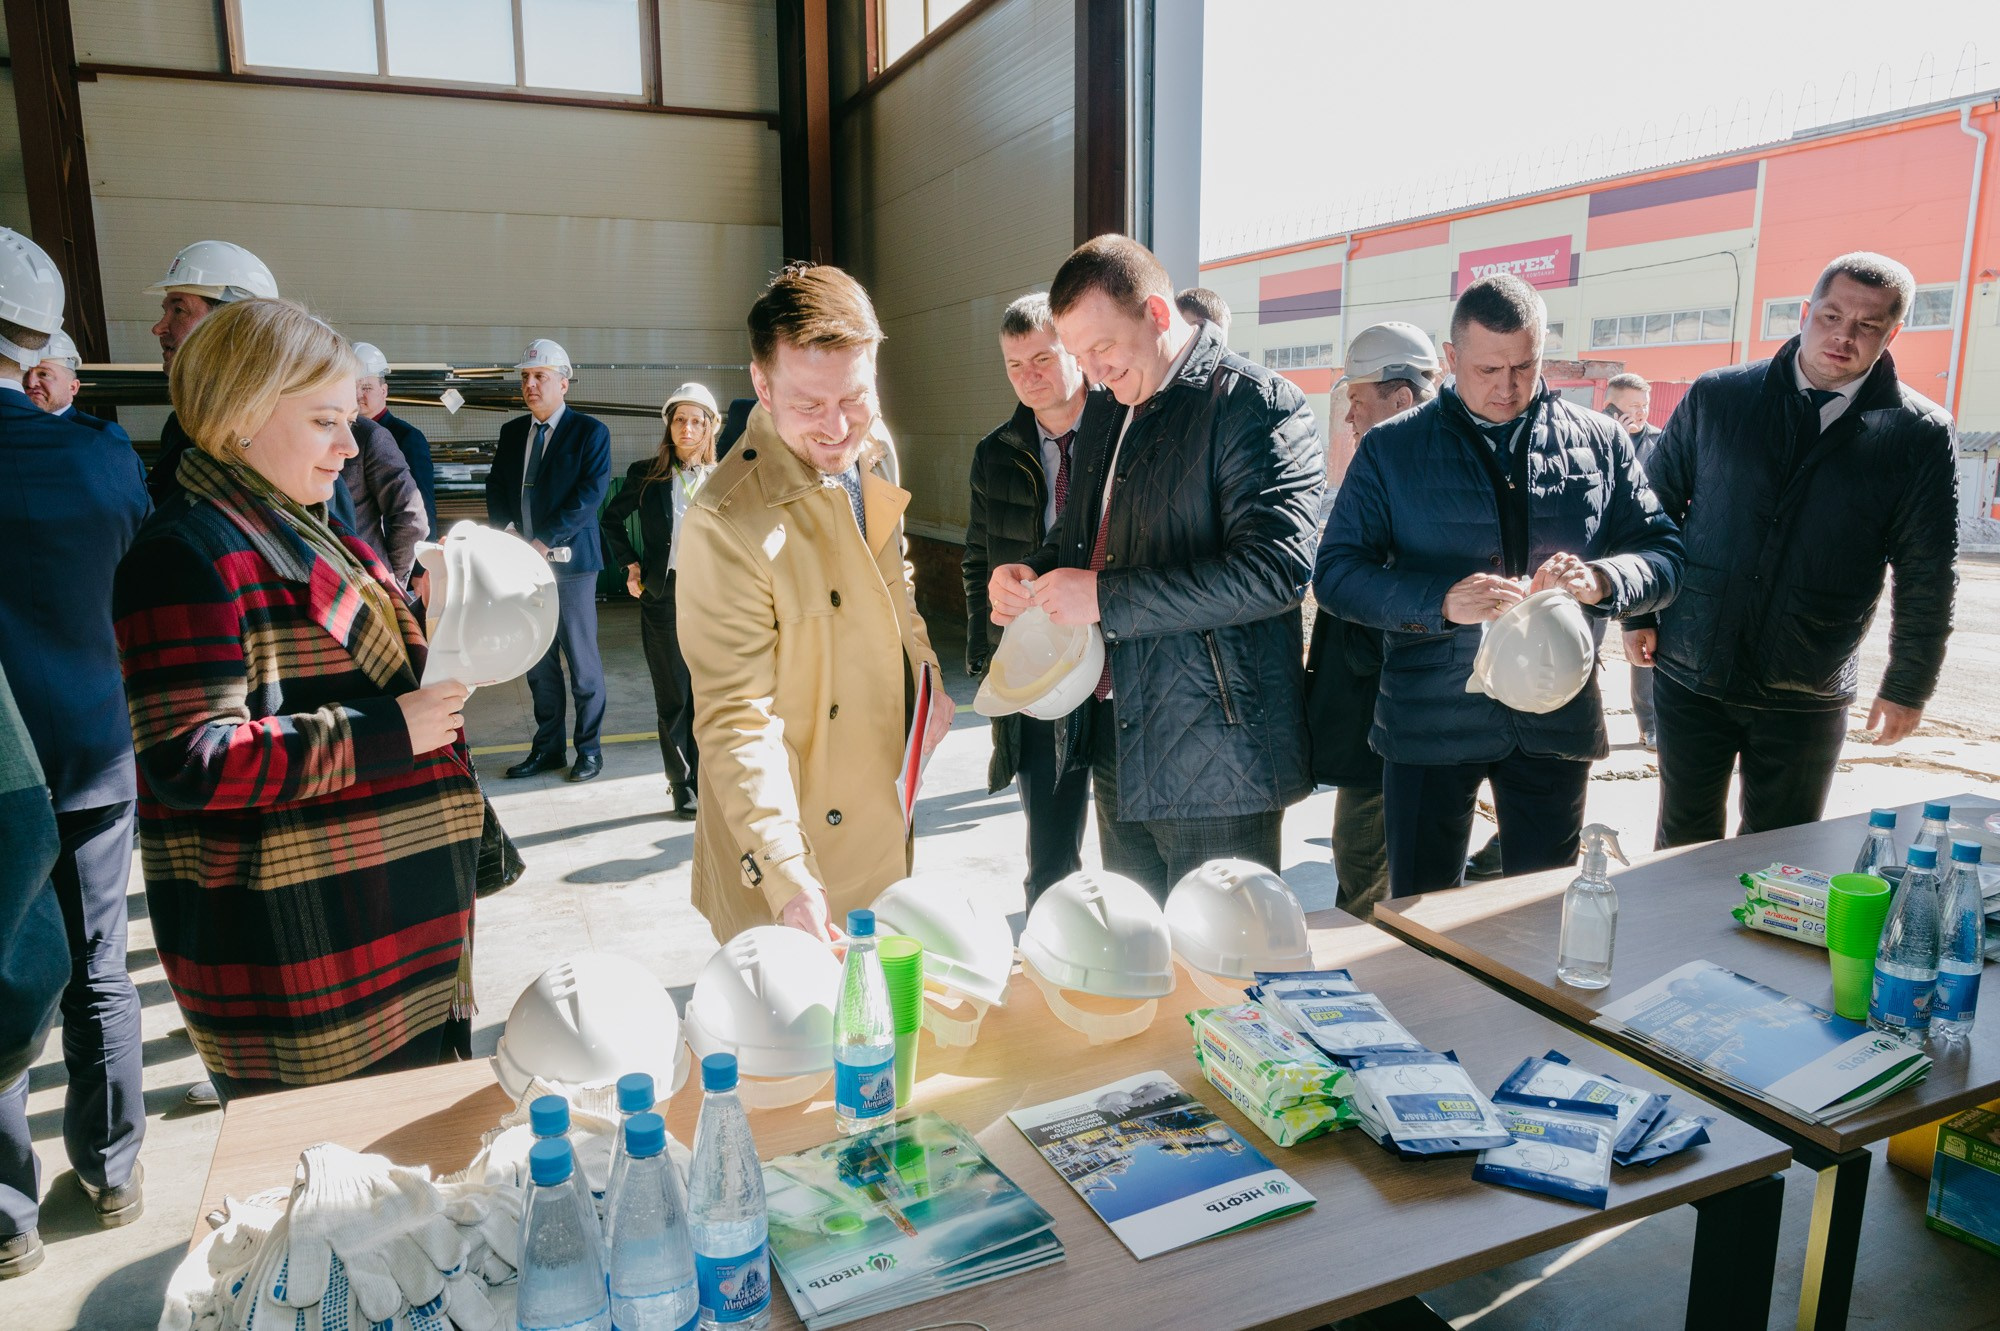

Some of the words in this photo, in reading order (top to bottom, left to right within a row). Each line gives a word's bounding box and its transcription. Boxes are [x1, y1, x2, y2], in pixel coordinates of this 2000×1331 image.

[1471, 255, 1556, 279] VORTEX
[1303, 1006, 1348, 1014] PROTECTIVE
[1313, 1012, 1340, 1020] FFP3
[1836, 1047, 1882, 1071] НЕФТЬ
[1441, 1102, 1472, 1110] FFP3
[1040, 1112, 1099, 1133] ОБОРУДОВАНИЯ
[1401, 1113, 1427, 1121] MASK
[1428, 1111, 1481, 1120] PROTECTIVE
[1049, 1119, 1107, 1140] ПРОИЗВОДСТВО
[1512, 1118, 1563, 1130] ROTECTIVE
[1565, 1125, 1594, 1135] MASK
[1515, 1124, 1540, 1134] FP3
[1206, 1189, 1266, 1213] НЕФТЬ
[808, 1266, 865, 1289] НЕФТЬ
